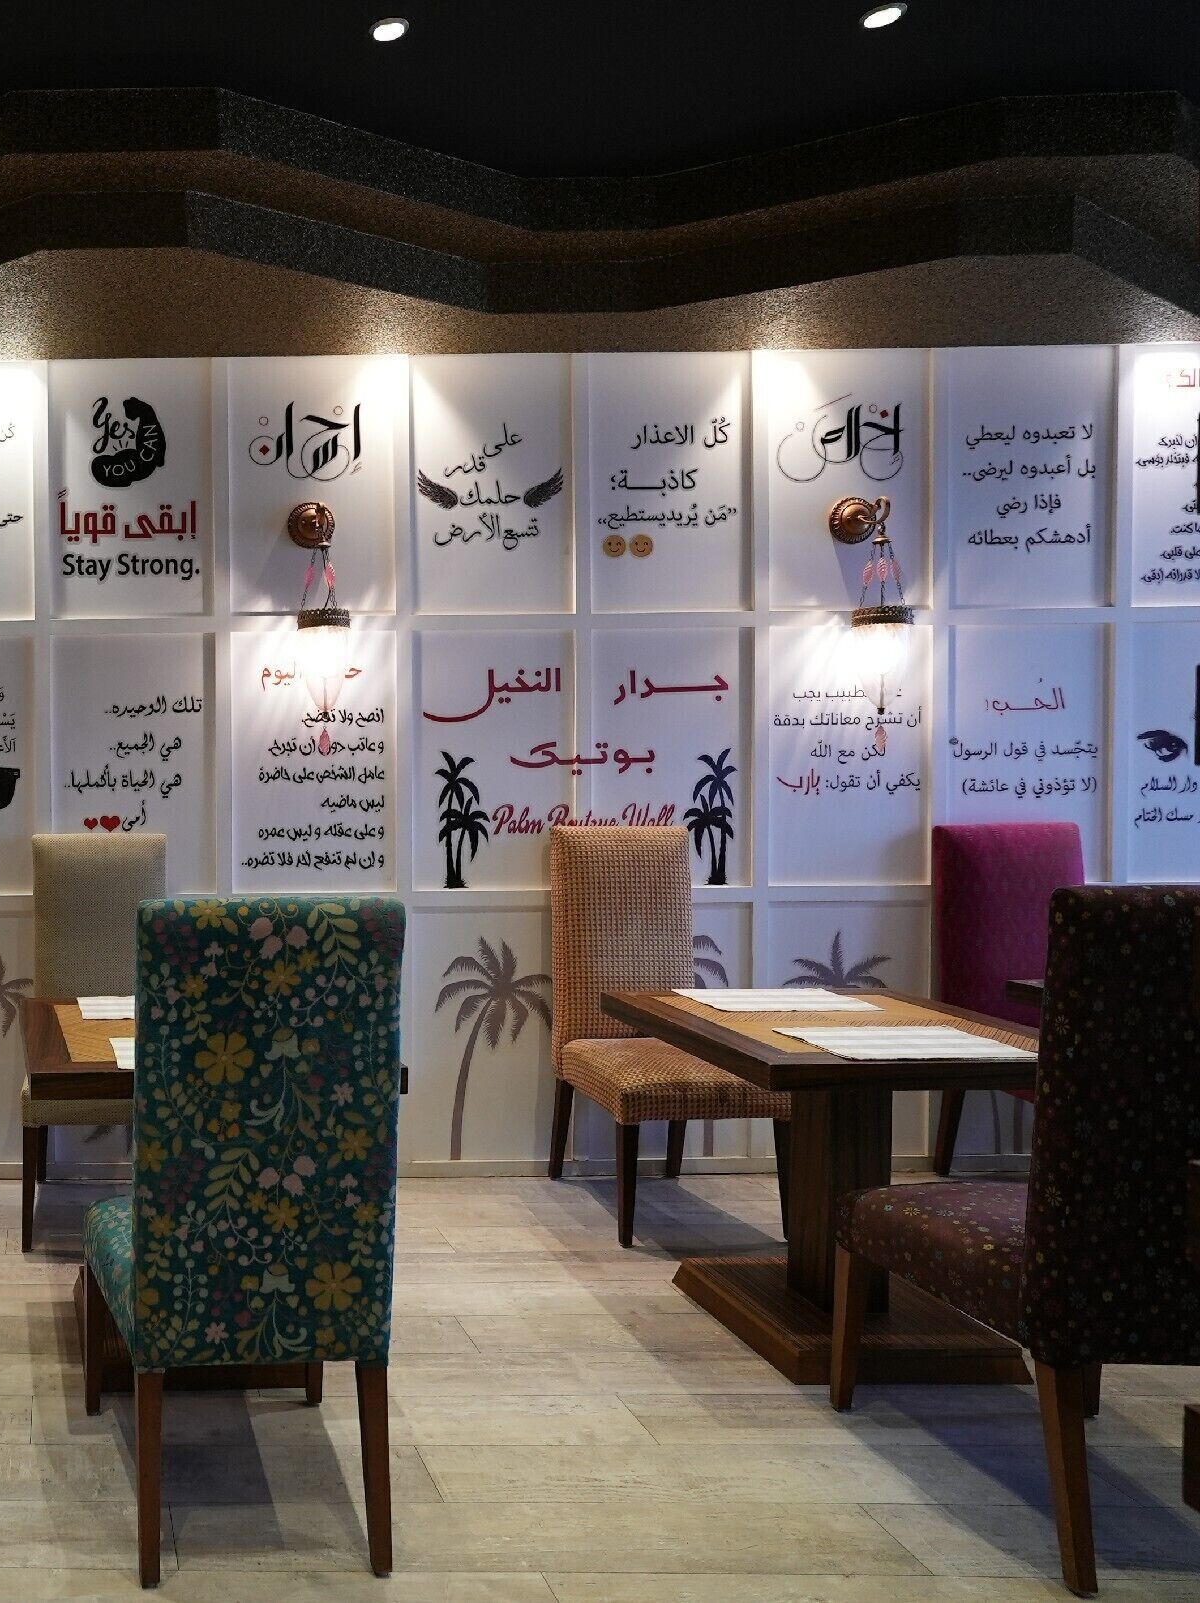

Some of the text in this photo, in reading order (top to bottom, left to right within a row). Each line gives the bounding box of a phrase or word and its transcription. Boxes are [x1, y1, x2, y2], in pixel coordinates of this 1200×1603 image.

[483, 423, 523, 457] على
[966, 424, 1093, 449] لا تعبدوه ليعطي
[103, 424, 158, 477] YOU CAN
[1020, 455, 1071, 479] أعبدوه
[1078, 459, 1096, 478] بل
[460, 480, 520, 506] حلمك
[997, 494, 1062, 518] فإذا رضي
[434, 512, 500, 546] الأرض
[968, 524, 1091, 553] أدهشكم بعطائه
[62, 553, 200, 581] Stay Strong.
[172, 696, 202, 713] تلك
[422, 667, 729, 723] جدار النخيل
[793, 689, 820, 701] يجب
[774, 714, 805, 729] بدقة
[810, 712, 861, 726] معاناتك
[907, 706, 922, 727] أن
[160, 736, 181, 761] هي
[509, 741, 655, 775] بوتيك
[838, 749, 855, 764] مع
[1003, 742, 1028, 759] قول
[1035, 741, 1046, 761] في
[160, 773, 181, 798] هي
[867, 770, 880, 790] أن
[886, 773, 920, 795] يكفي
[1015, 778, 1026, 798] في
[1033, 778, 1075, 798] تؤذوني
[492, 803, 545, 835] Palm
